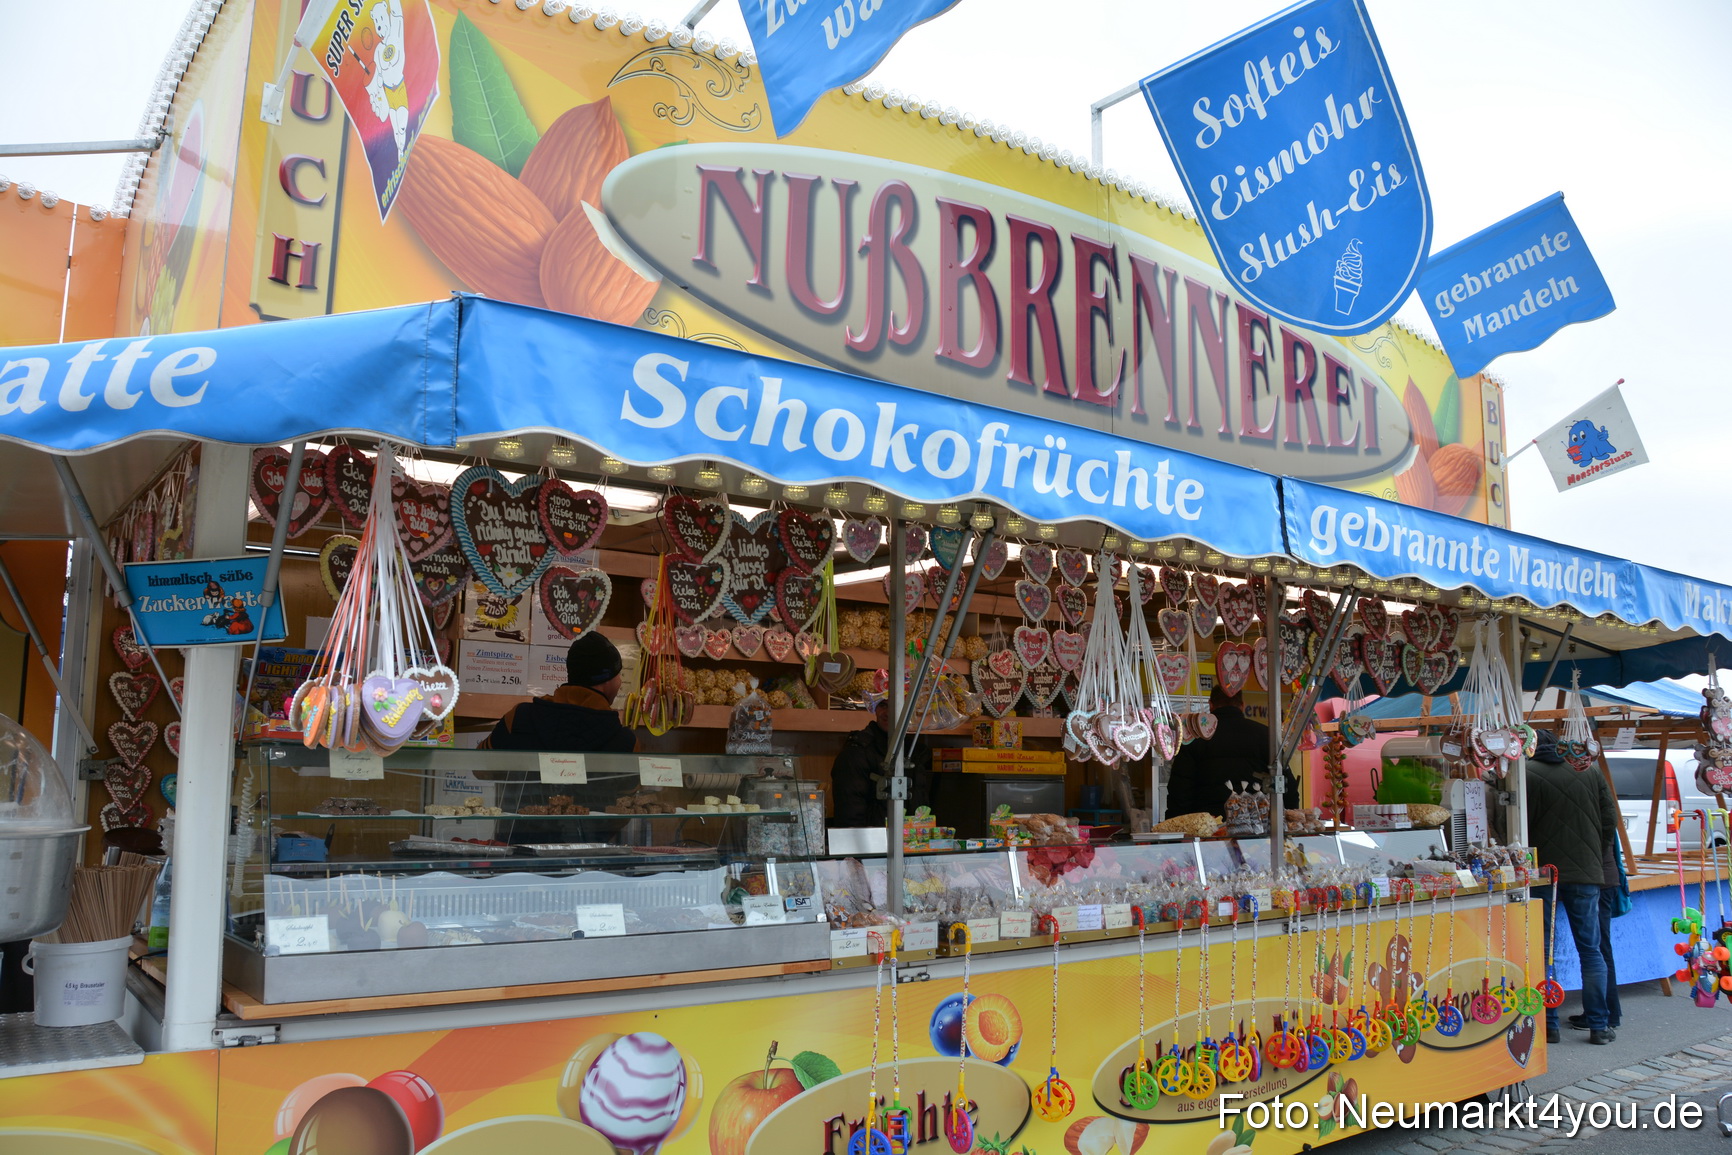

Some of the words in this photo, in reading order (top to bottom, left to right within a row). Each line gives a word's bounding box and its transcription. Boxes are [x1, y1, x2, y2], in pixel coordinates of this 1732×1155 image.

[326, 10, 355, 77] SUPER
[1193, 26, 1341, 150] Softeis
[1208, 86, 1382, 221] Eismohr
[1240, 161, 1407, 284] Slush-Eis
[1434, 229, 1572, 318] gebrannte
[1462, 274, 1580, 345] Mandeln
[620, 353, 1205, 521] Schokofrüchte
[1486, 400, 1503, 528] BUC
[342, 463, 366, 482] Ich
[340, 481, 369, 499] liebe
[549, 494, 571, 508] 1000
[478, 500, 502, 521] Du
[676, 509, 694, 523] Ich
[567, 520, 587, 533] Dich
[679, 524, 703, 538] liebe
[789, 524, 807, 536] Ich
[687, 537, 708, 551] Dich
[791, 536, 813, 549] liebe
[492, 543, 535, 564] Dirndl
[797, 548, 817, 560] Dich
[1308, 504, 1500, 580] gebrannte
[1508, 545, 1618, 600] Mandeln
[423, 552, 465, 567] ernasch
[422, 562, 450, 575] mich
[671, 569, 693, 582] Ich
[552, 585, 570, 599] Ich
[672, 583, 698, 598] liebe
[786, 583, 800, 595] Ich
[555, 600, 578, 613] liebe
[678, 597, 701, 610] Dich
[786, 595, 805, 608] liebe
[558, 611, 582, 625] Dich
[790, 607, 806, 620] Dich
[476, 649, 514, 660] Zimtspitze
[259, 662, 299, 676] LIGHT
[1177, 1101, 1195, 1113] aus
